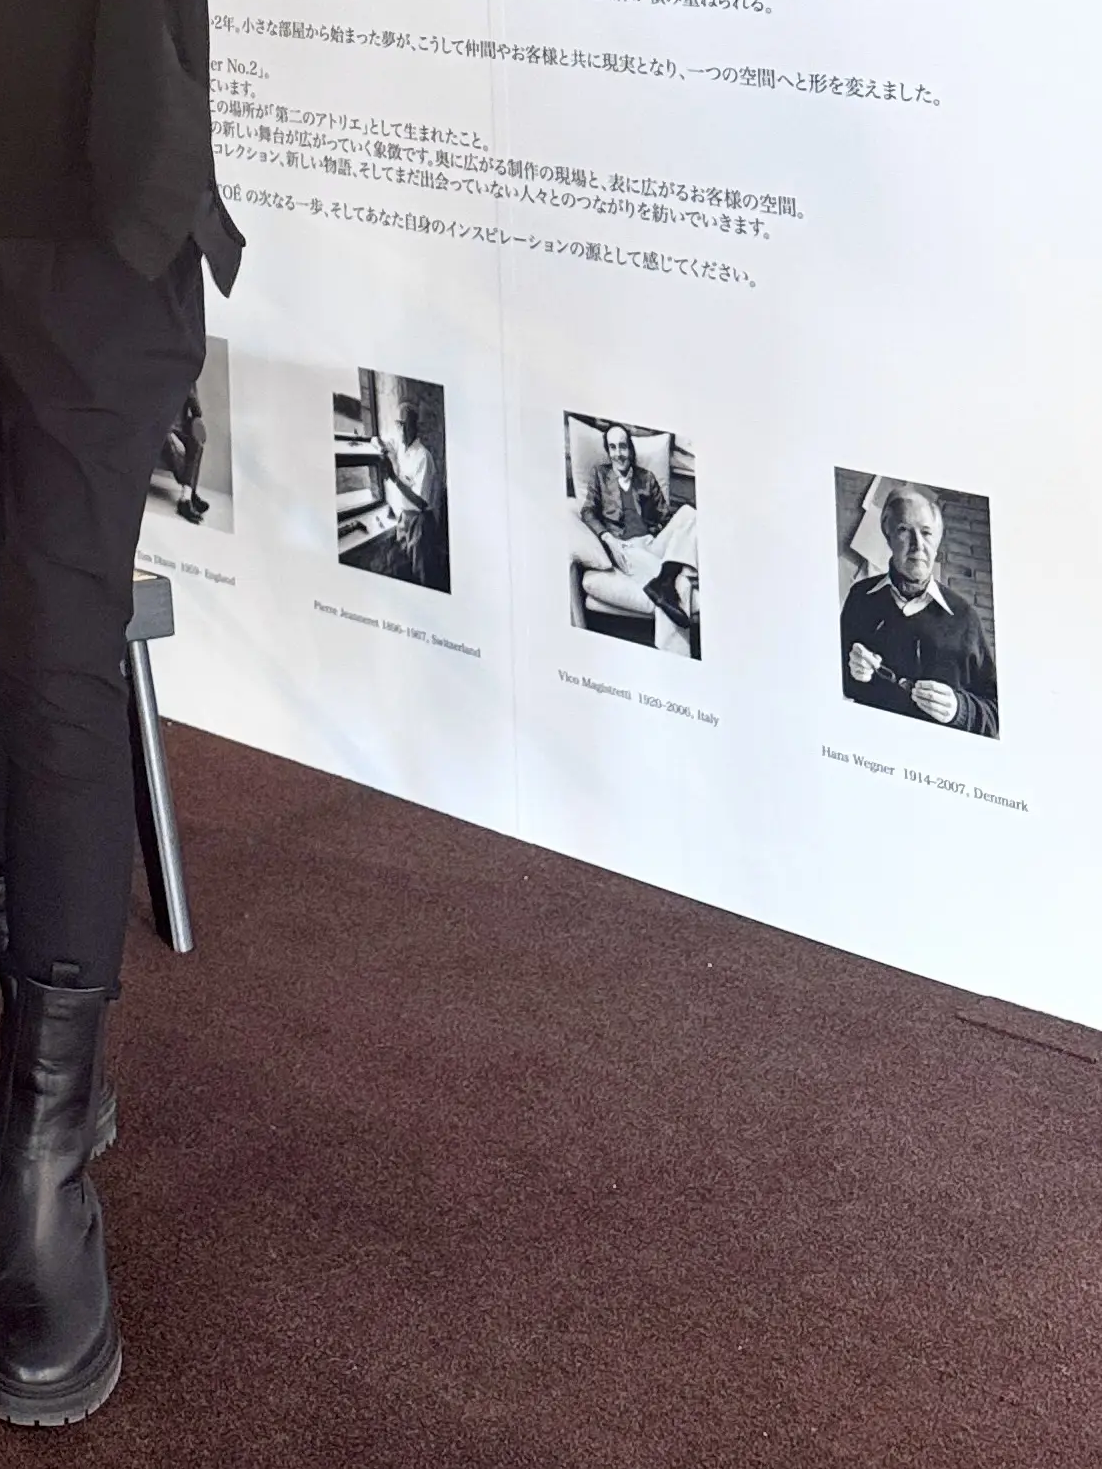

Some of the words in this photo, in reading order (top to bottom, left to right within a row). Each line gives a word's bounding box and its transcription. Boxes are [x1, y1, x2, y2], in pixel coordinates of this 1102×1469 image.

[211, 15, 941, 107] 2年。小さな部屋から始まった夢が、こうして仲間やお客様と共に現実となり、一つの空間へと形を変えました。
[696, 708, 720, 727] Italy
[821, 744, 850, 763] Hans
[852, 753, 896, 776] Wegner
[973, 786, 1029, 812] Denmark
